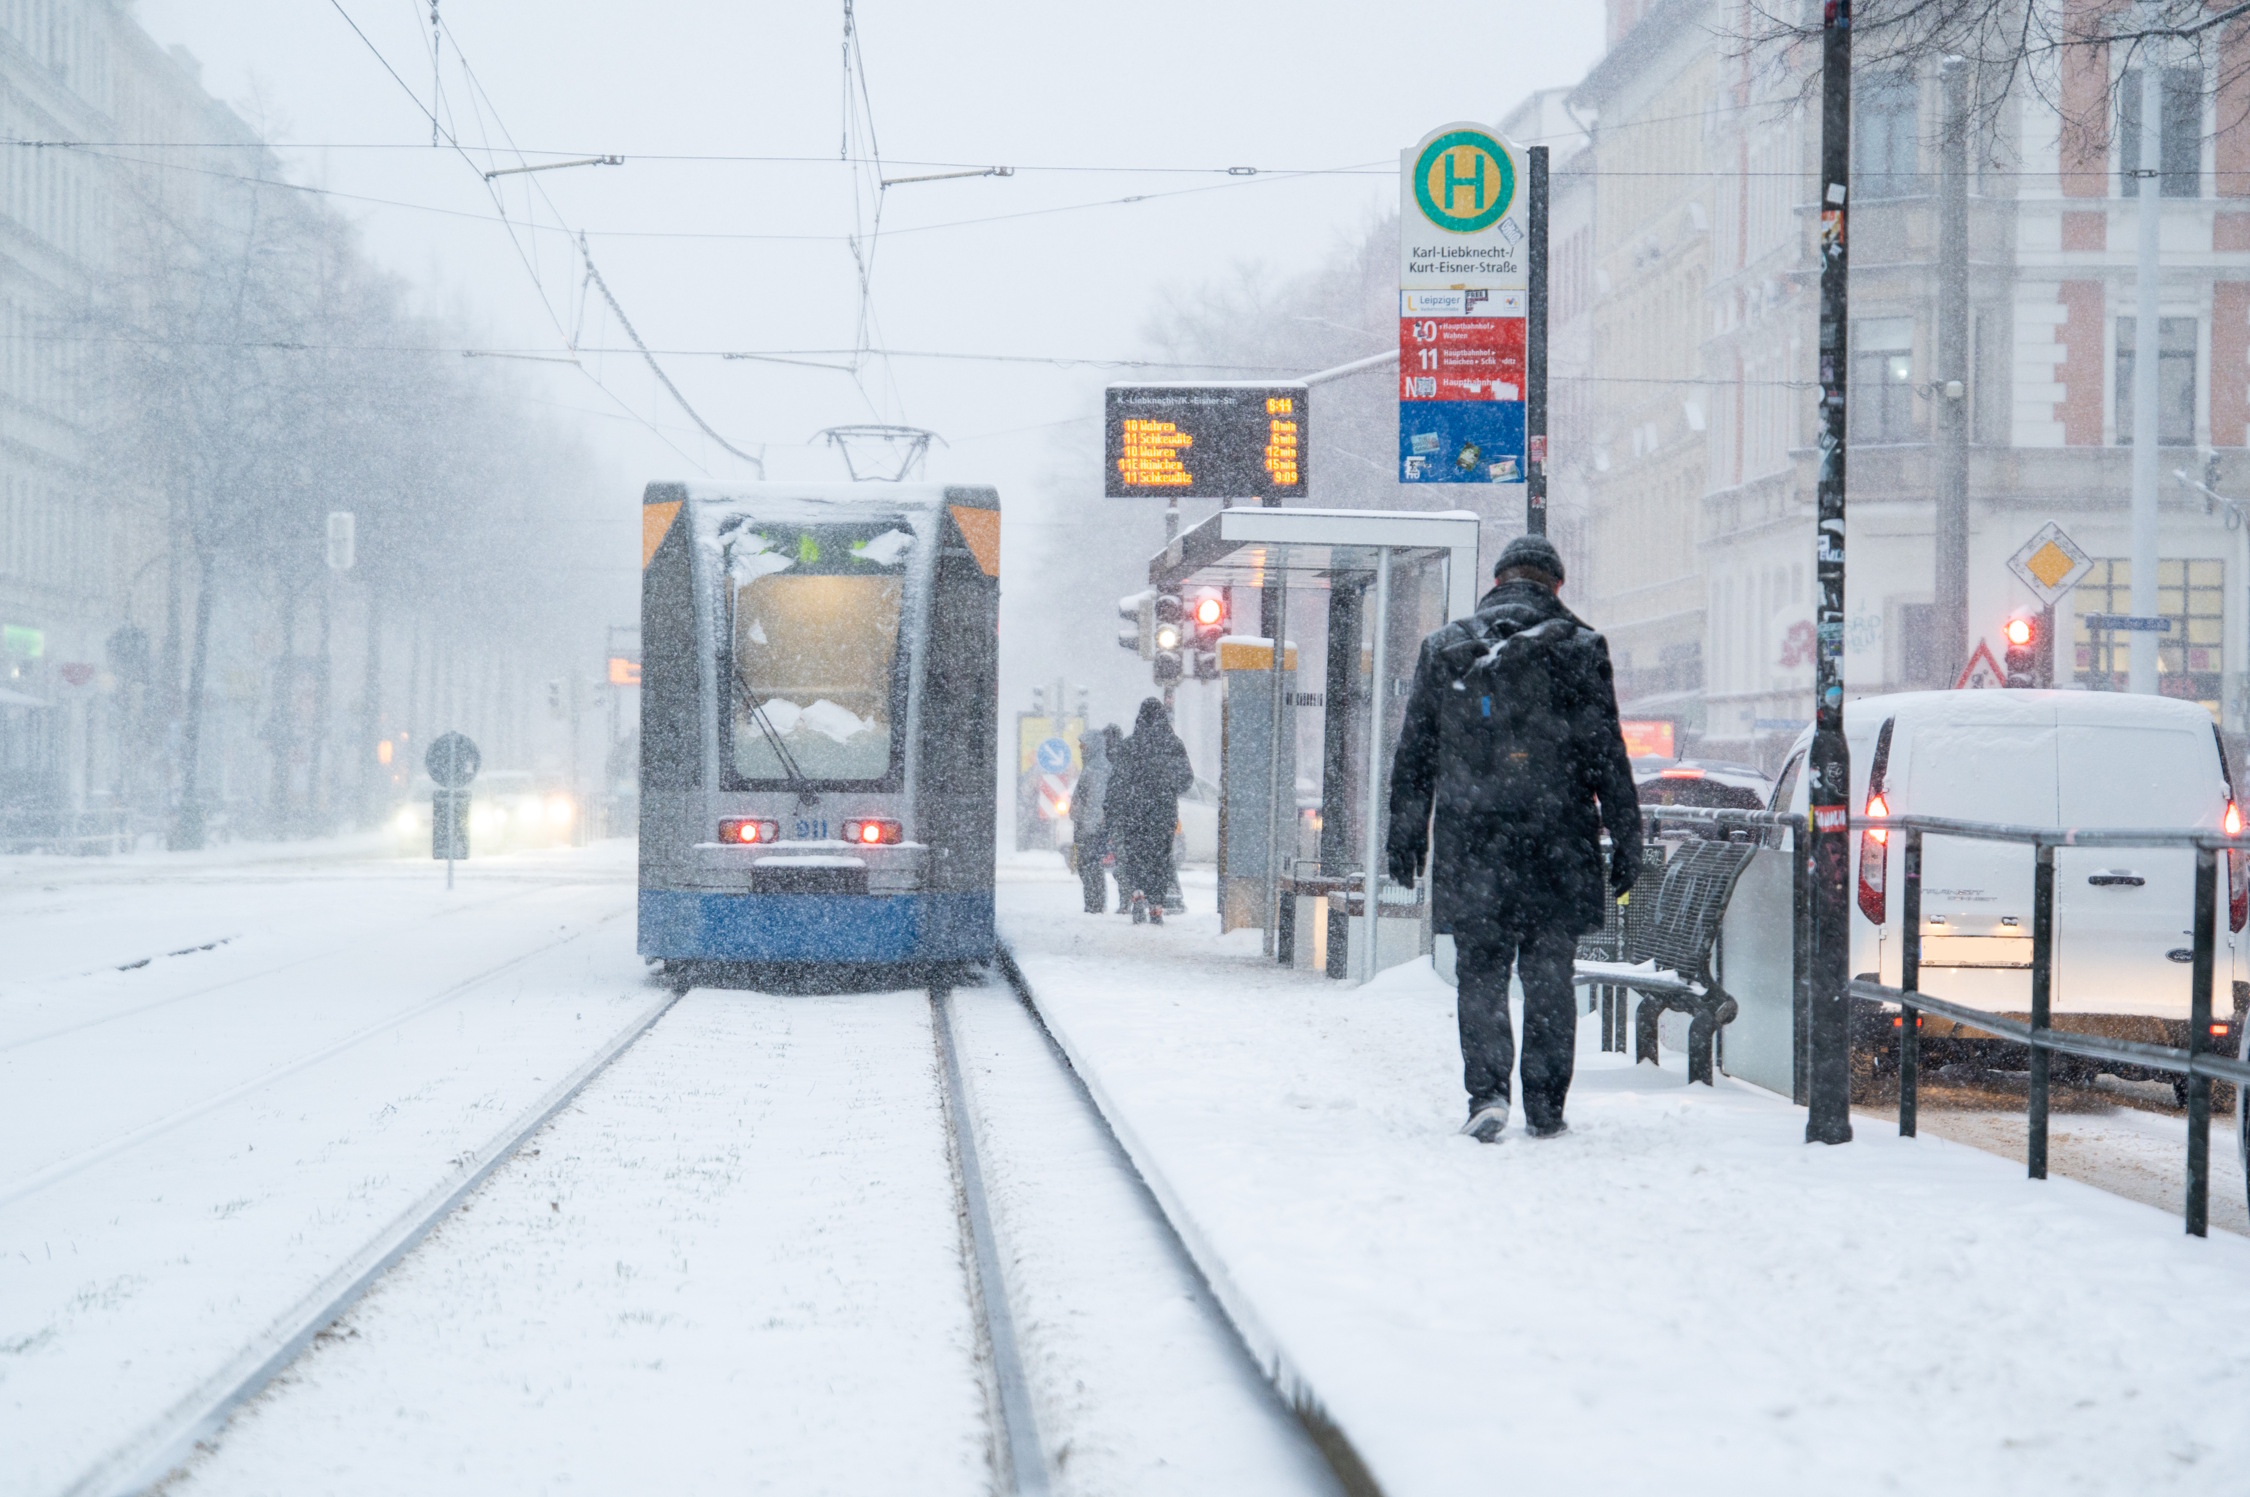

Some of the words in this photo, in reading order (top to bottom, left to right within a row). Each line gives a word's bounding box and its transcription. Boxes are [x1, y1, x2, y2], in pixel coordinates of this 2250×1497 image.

[1445, 154, 1484, 209] H
[1413, 246, 1515, 258] Karl-Liebknecht-/
[1409, 261, 1518, 273] Kurt-Eisner-Straße
[1420, 295, 1461, 306] Leipziger
[1443, 323, 1490, 331] Hauptbahnhof
[1418, 348, 1438, 370] 11
[1443, 349, 1491, 357] Hauptbahnhof
[1267, 398, 1292, 413] 8:44
[1124, 420, 1138, 432] 10
[1140, 419, 1175, 432] Wahren
[1124, 433, 1138, 445] 11
[1140, 432, 1192, 445] Schkeuditz
[1124, 446, 1138, 458] 10
[1140, 446, 1175, 458] Wahren
[1118, 458, 1139, 471] 11E
[1124, 472, 1138, 484] 11
[1140, 471, 1192, 484] Schkeuditz
[1273, 471, 1298, 484] 9:09
[796, 819, 828, 838] 911
[1921, 888, 1985, 896] TRANSIT
